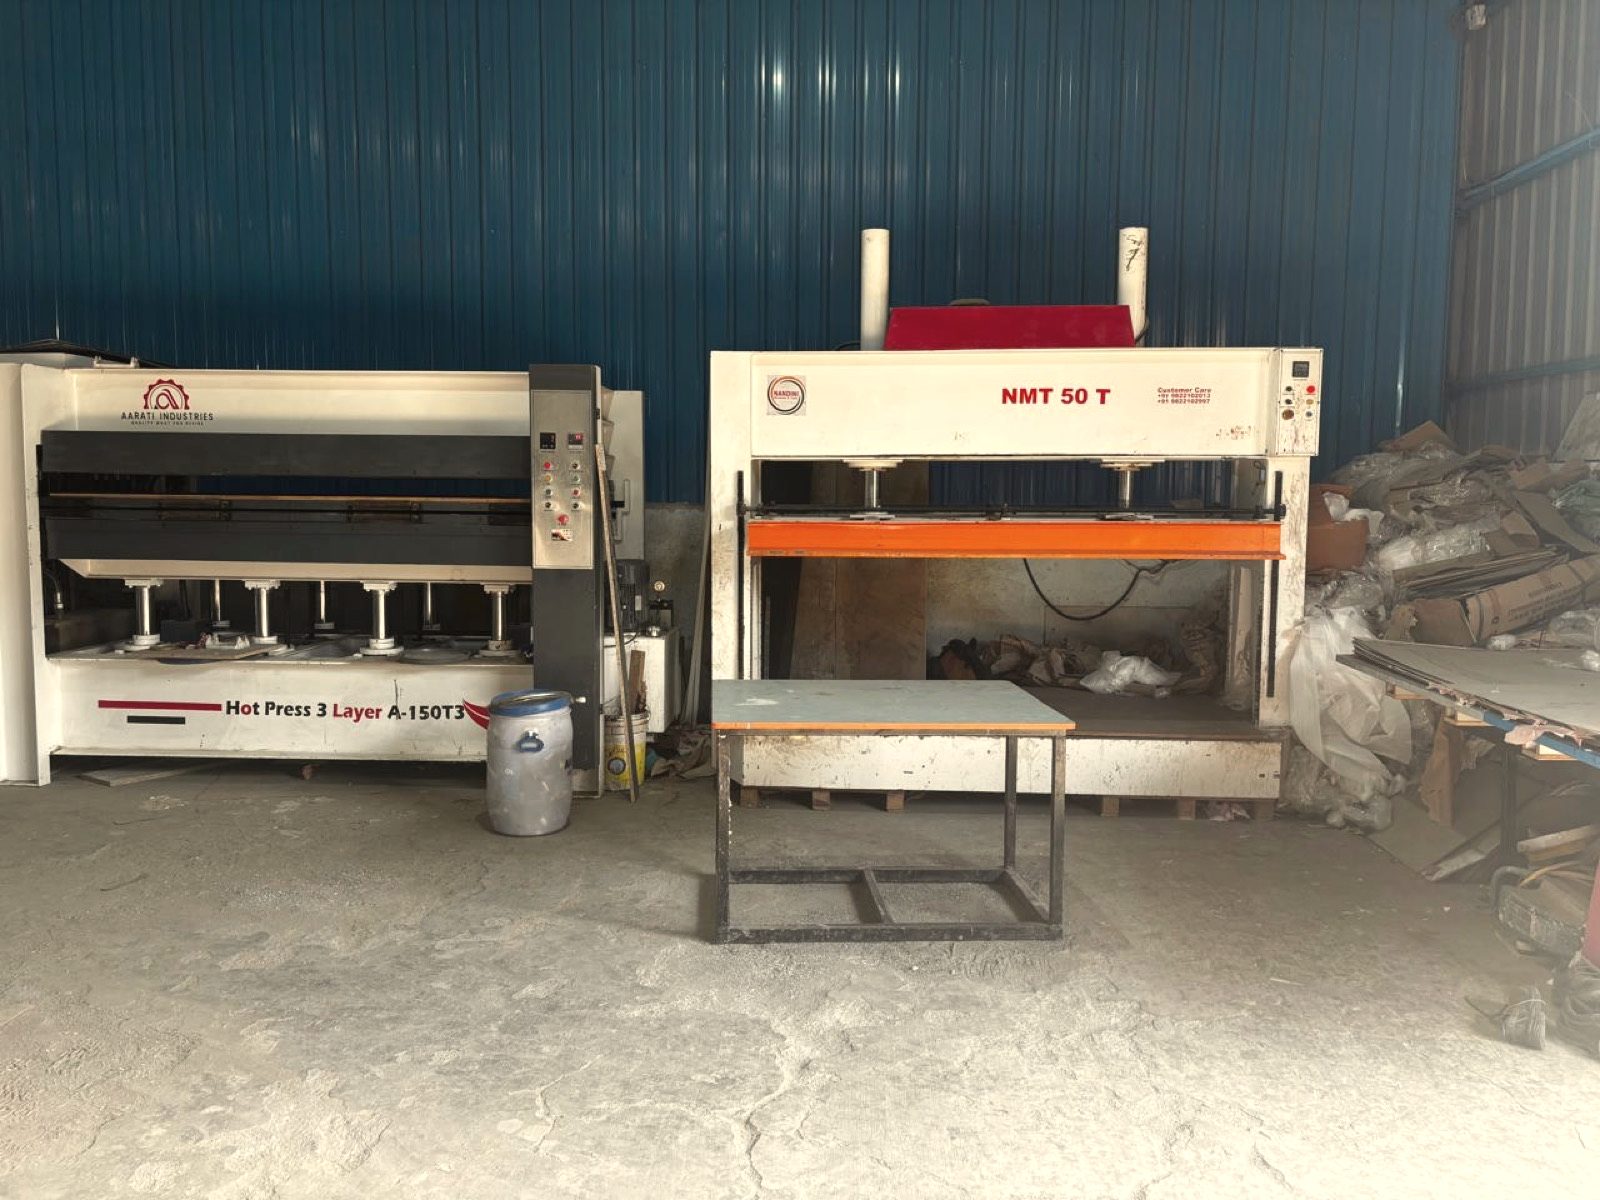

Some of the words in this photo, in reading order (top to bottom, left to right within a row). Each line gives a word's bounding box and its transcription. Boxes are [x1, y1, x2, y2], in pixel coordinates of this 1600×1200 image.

[1001, 388, 1053, 405] NMT
[1060, 388, 1088, 405] 50
[1095, 388, 1111, 405] T
[121, 411, 155, 420] AARATI
[160, 411, 214, 421] INDUSTRIES
[225, 700, 260, 716] Hot
[264, 701, 311, 717] Press
[316, 702, 327, 717] 3
[333, 703, 382, 723] Layer
[387, 704, 465, 720] A-150T3
